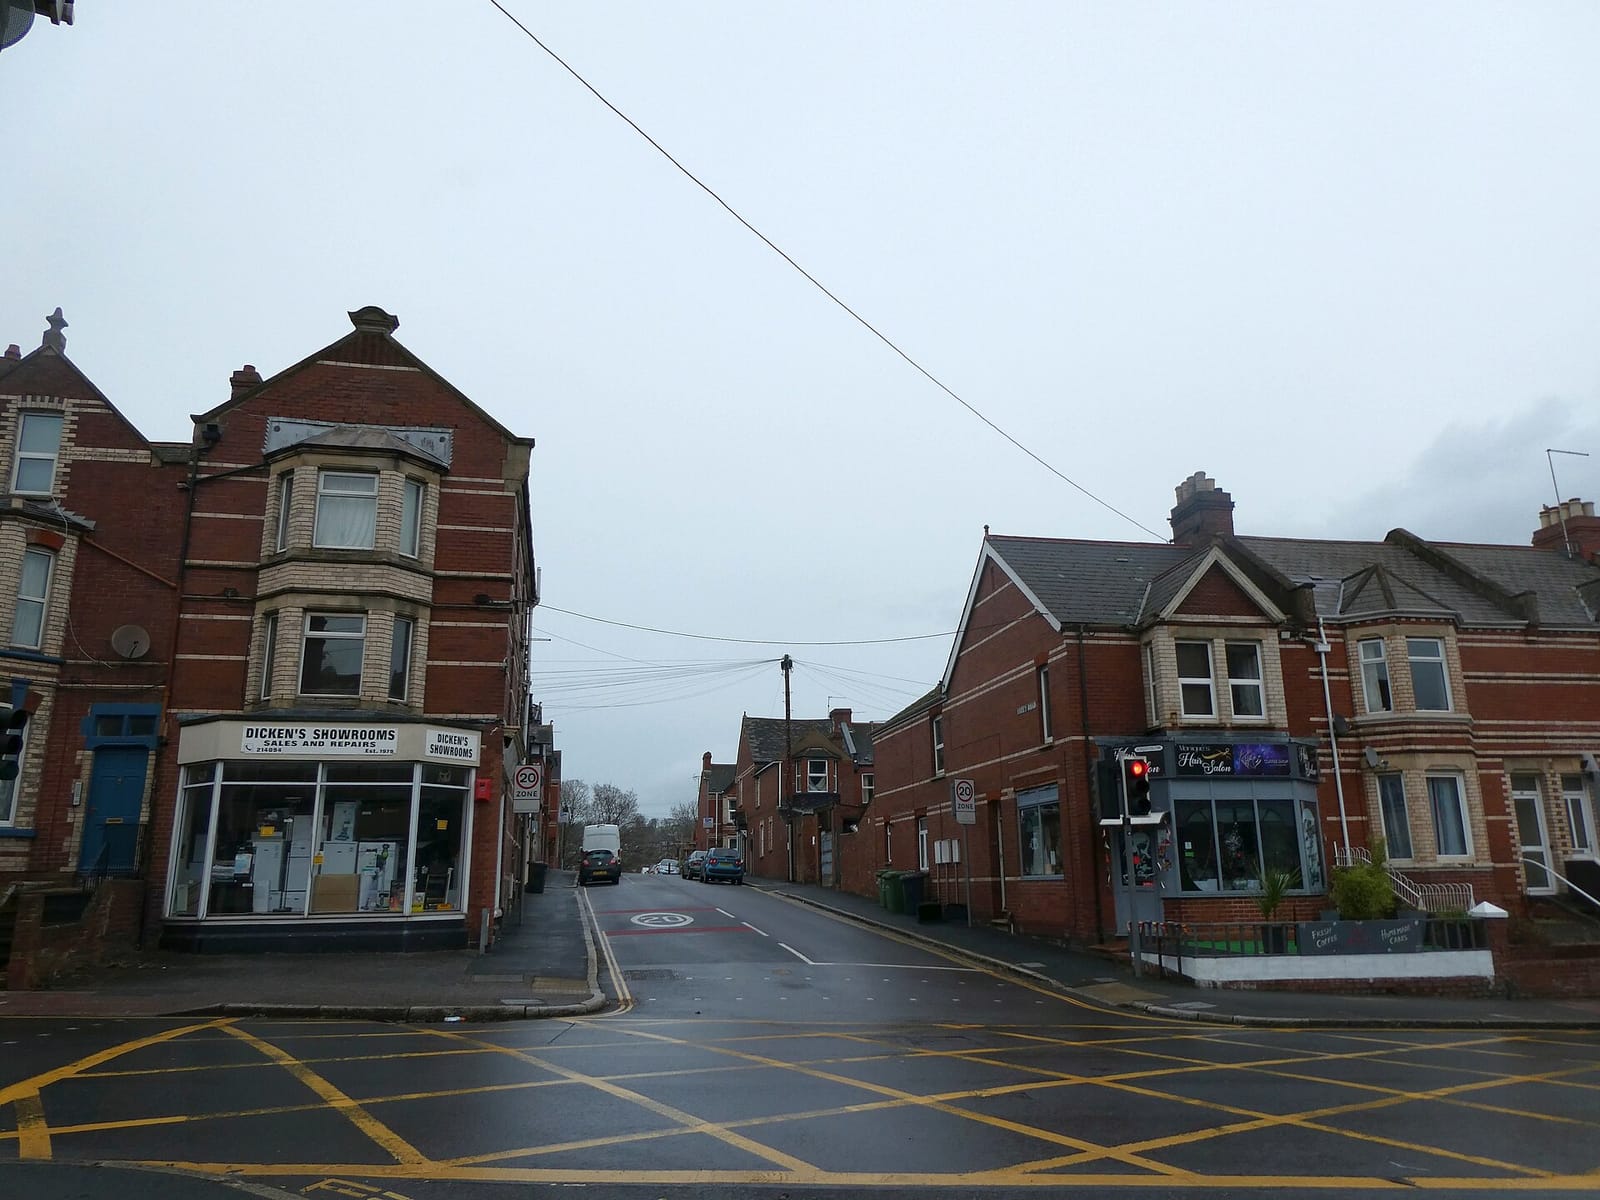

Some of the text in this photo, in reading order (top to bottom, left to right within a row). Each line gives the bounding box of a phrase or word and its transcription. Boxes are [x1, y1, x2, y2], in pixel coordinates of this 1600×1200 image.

[245, 728, 395, 740] DICKEN'S SHOWROOMS
[437, 733, 468, 746] DICKEN'S
[430, 744, 473, 758] SHOWROOMS
[1178, 752, 1203, 767] Hair
[1202, 759, 1231, 775] Salon
[520, 773, 536, 783] 20
[959, 786, 971, 796] 20
